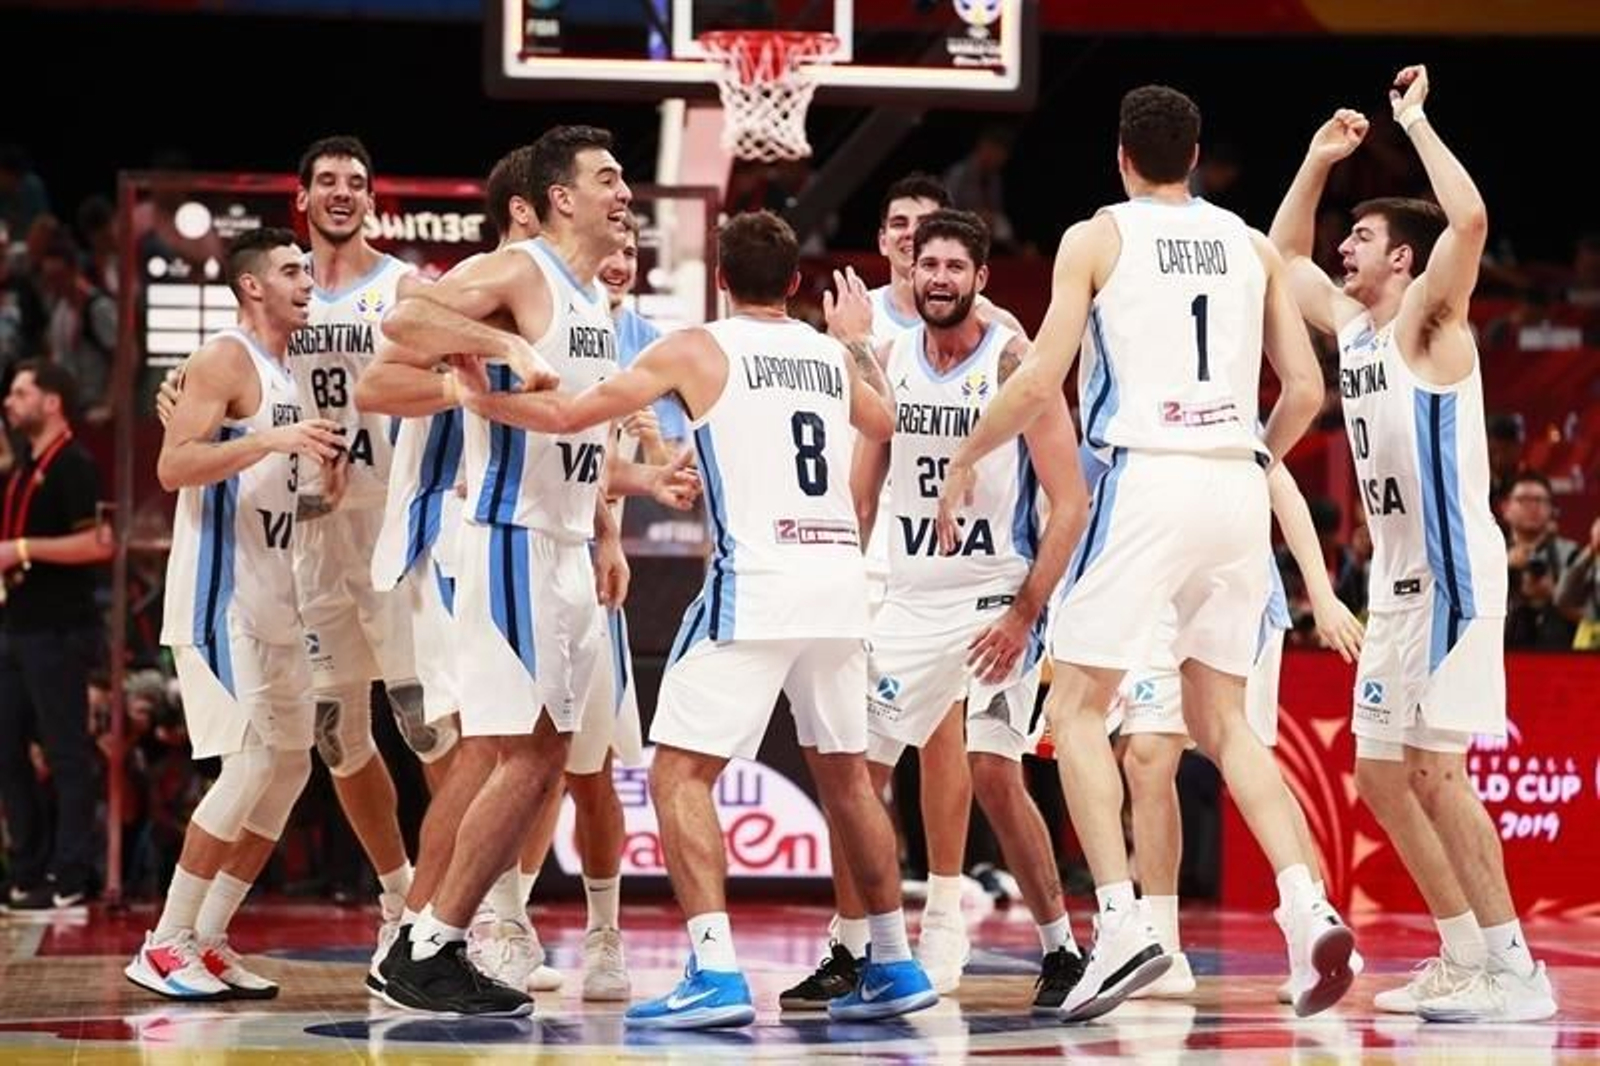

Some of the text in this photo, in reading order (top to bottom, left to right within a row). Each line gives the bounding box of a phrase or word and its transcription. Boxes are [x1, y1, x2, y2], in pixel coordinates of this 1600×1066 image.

[1156, 239, 1228, 275] CAFFARO
[287, 323, 374, 357] ARGENTINA
[569, 326, 617, 361] ARGENTI
[1191, 294, 1210, 382] 1
[311, 367, 347, 408] 83
[894, 402, 980, 437] RGENTIN
[556, 441, 605, 484] VIS
[791, 410, 828, 497] 8
[1362, 476, 1406, 516] ISA
[256, 509, 293, 549] VI
[1516, 774, 1582, 803] CUP
[1501, 811, 1560, 842] 2019
